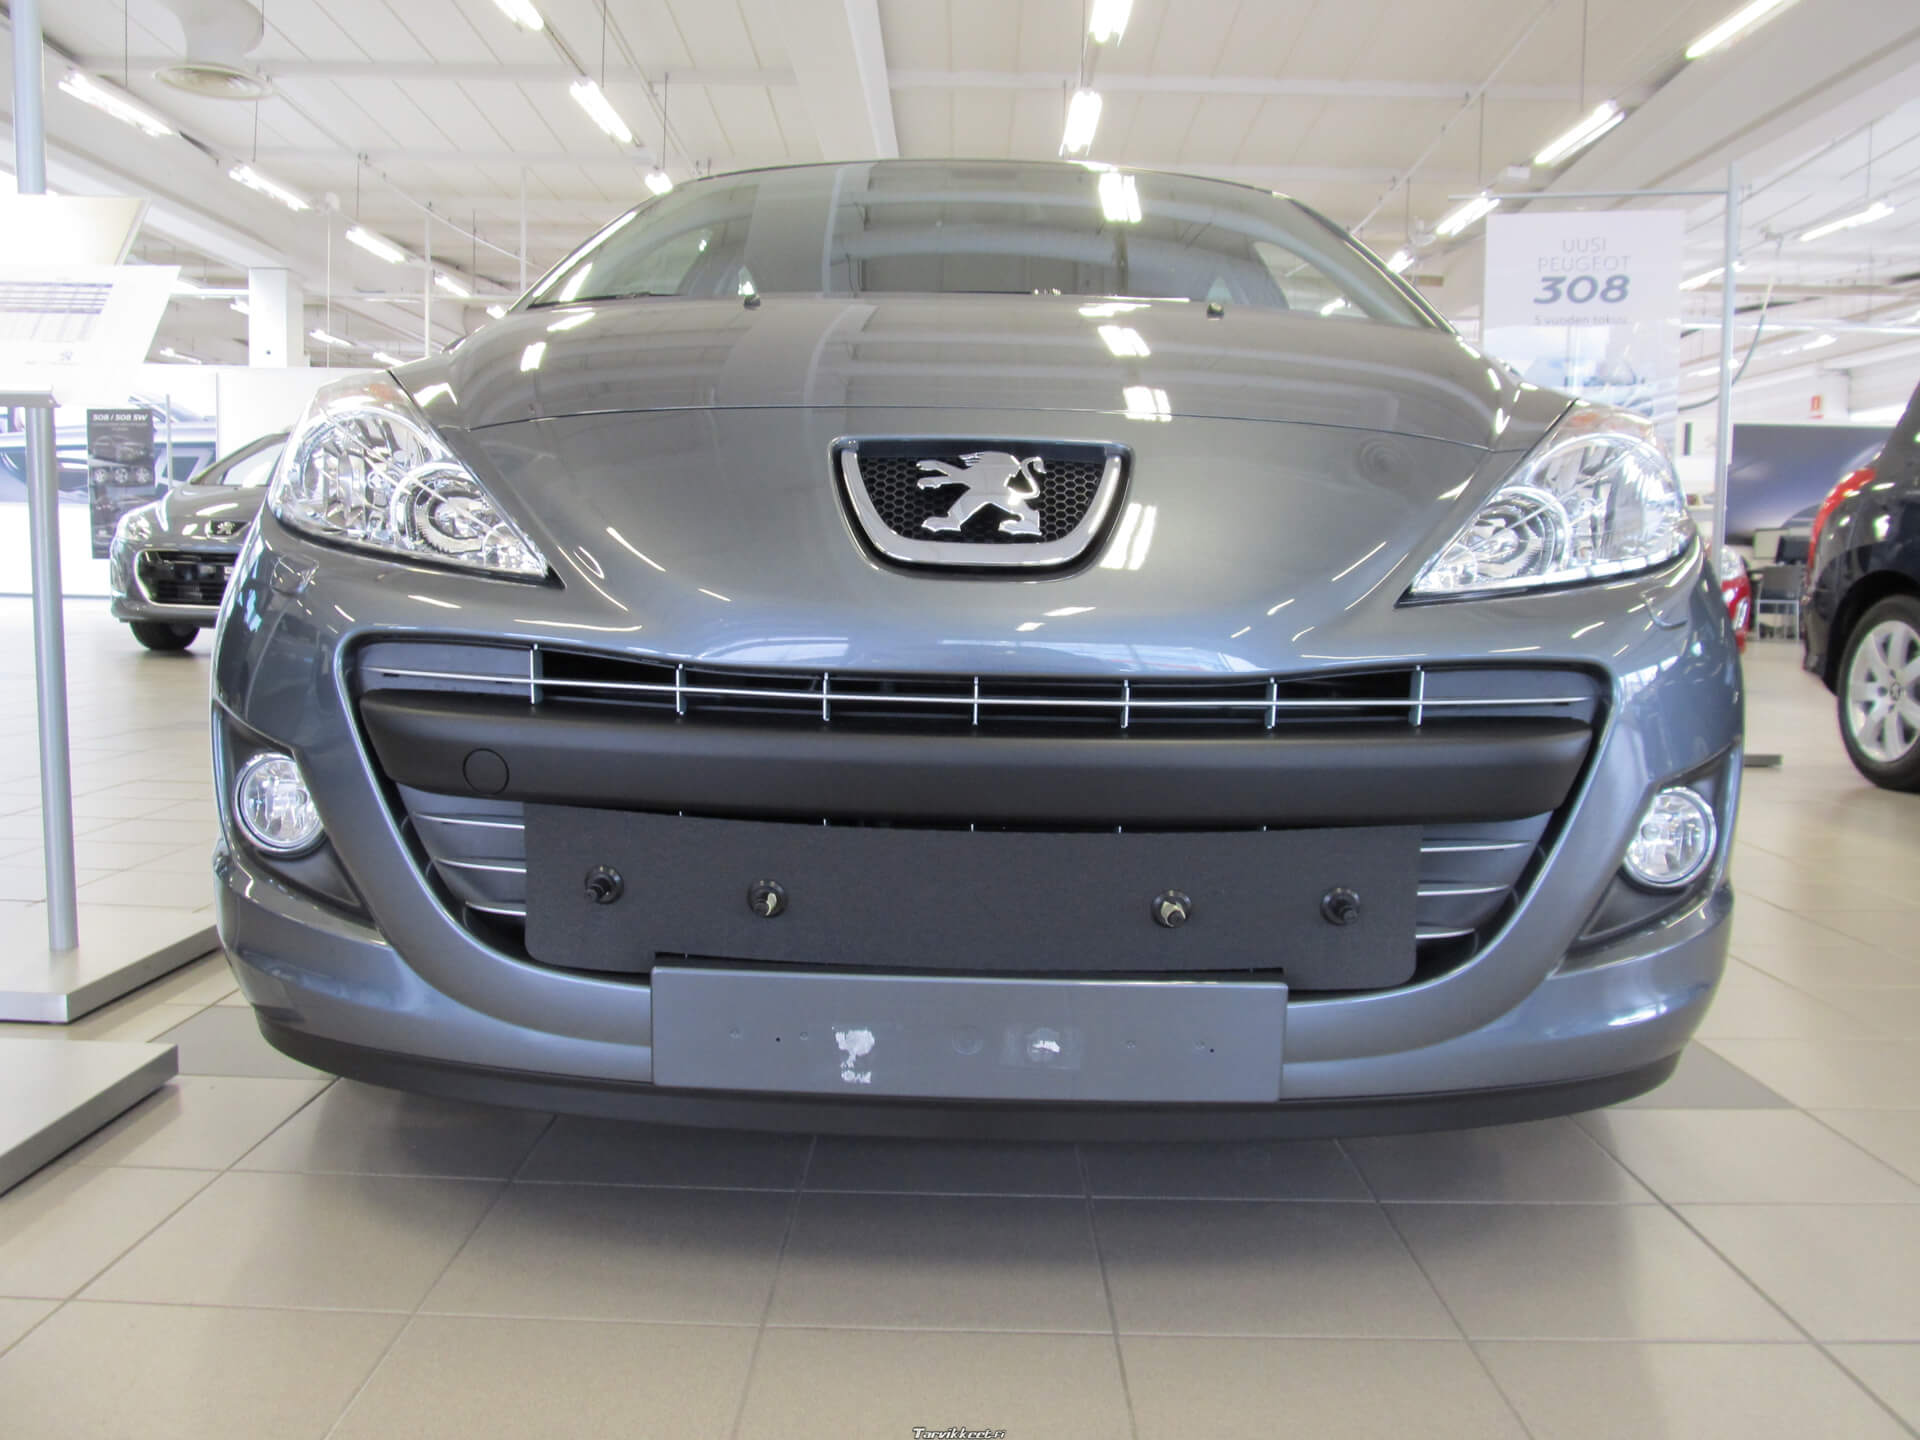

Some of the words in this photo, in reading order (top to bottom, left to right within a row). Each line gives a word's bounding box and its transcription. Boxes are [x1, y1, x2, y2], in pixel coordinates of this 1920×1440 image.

[1562, 237, 1608, 253] UUSI
[1537, 255, 1632, 273] PEUGEOT
[1533, 273, 1631, 304] 308
